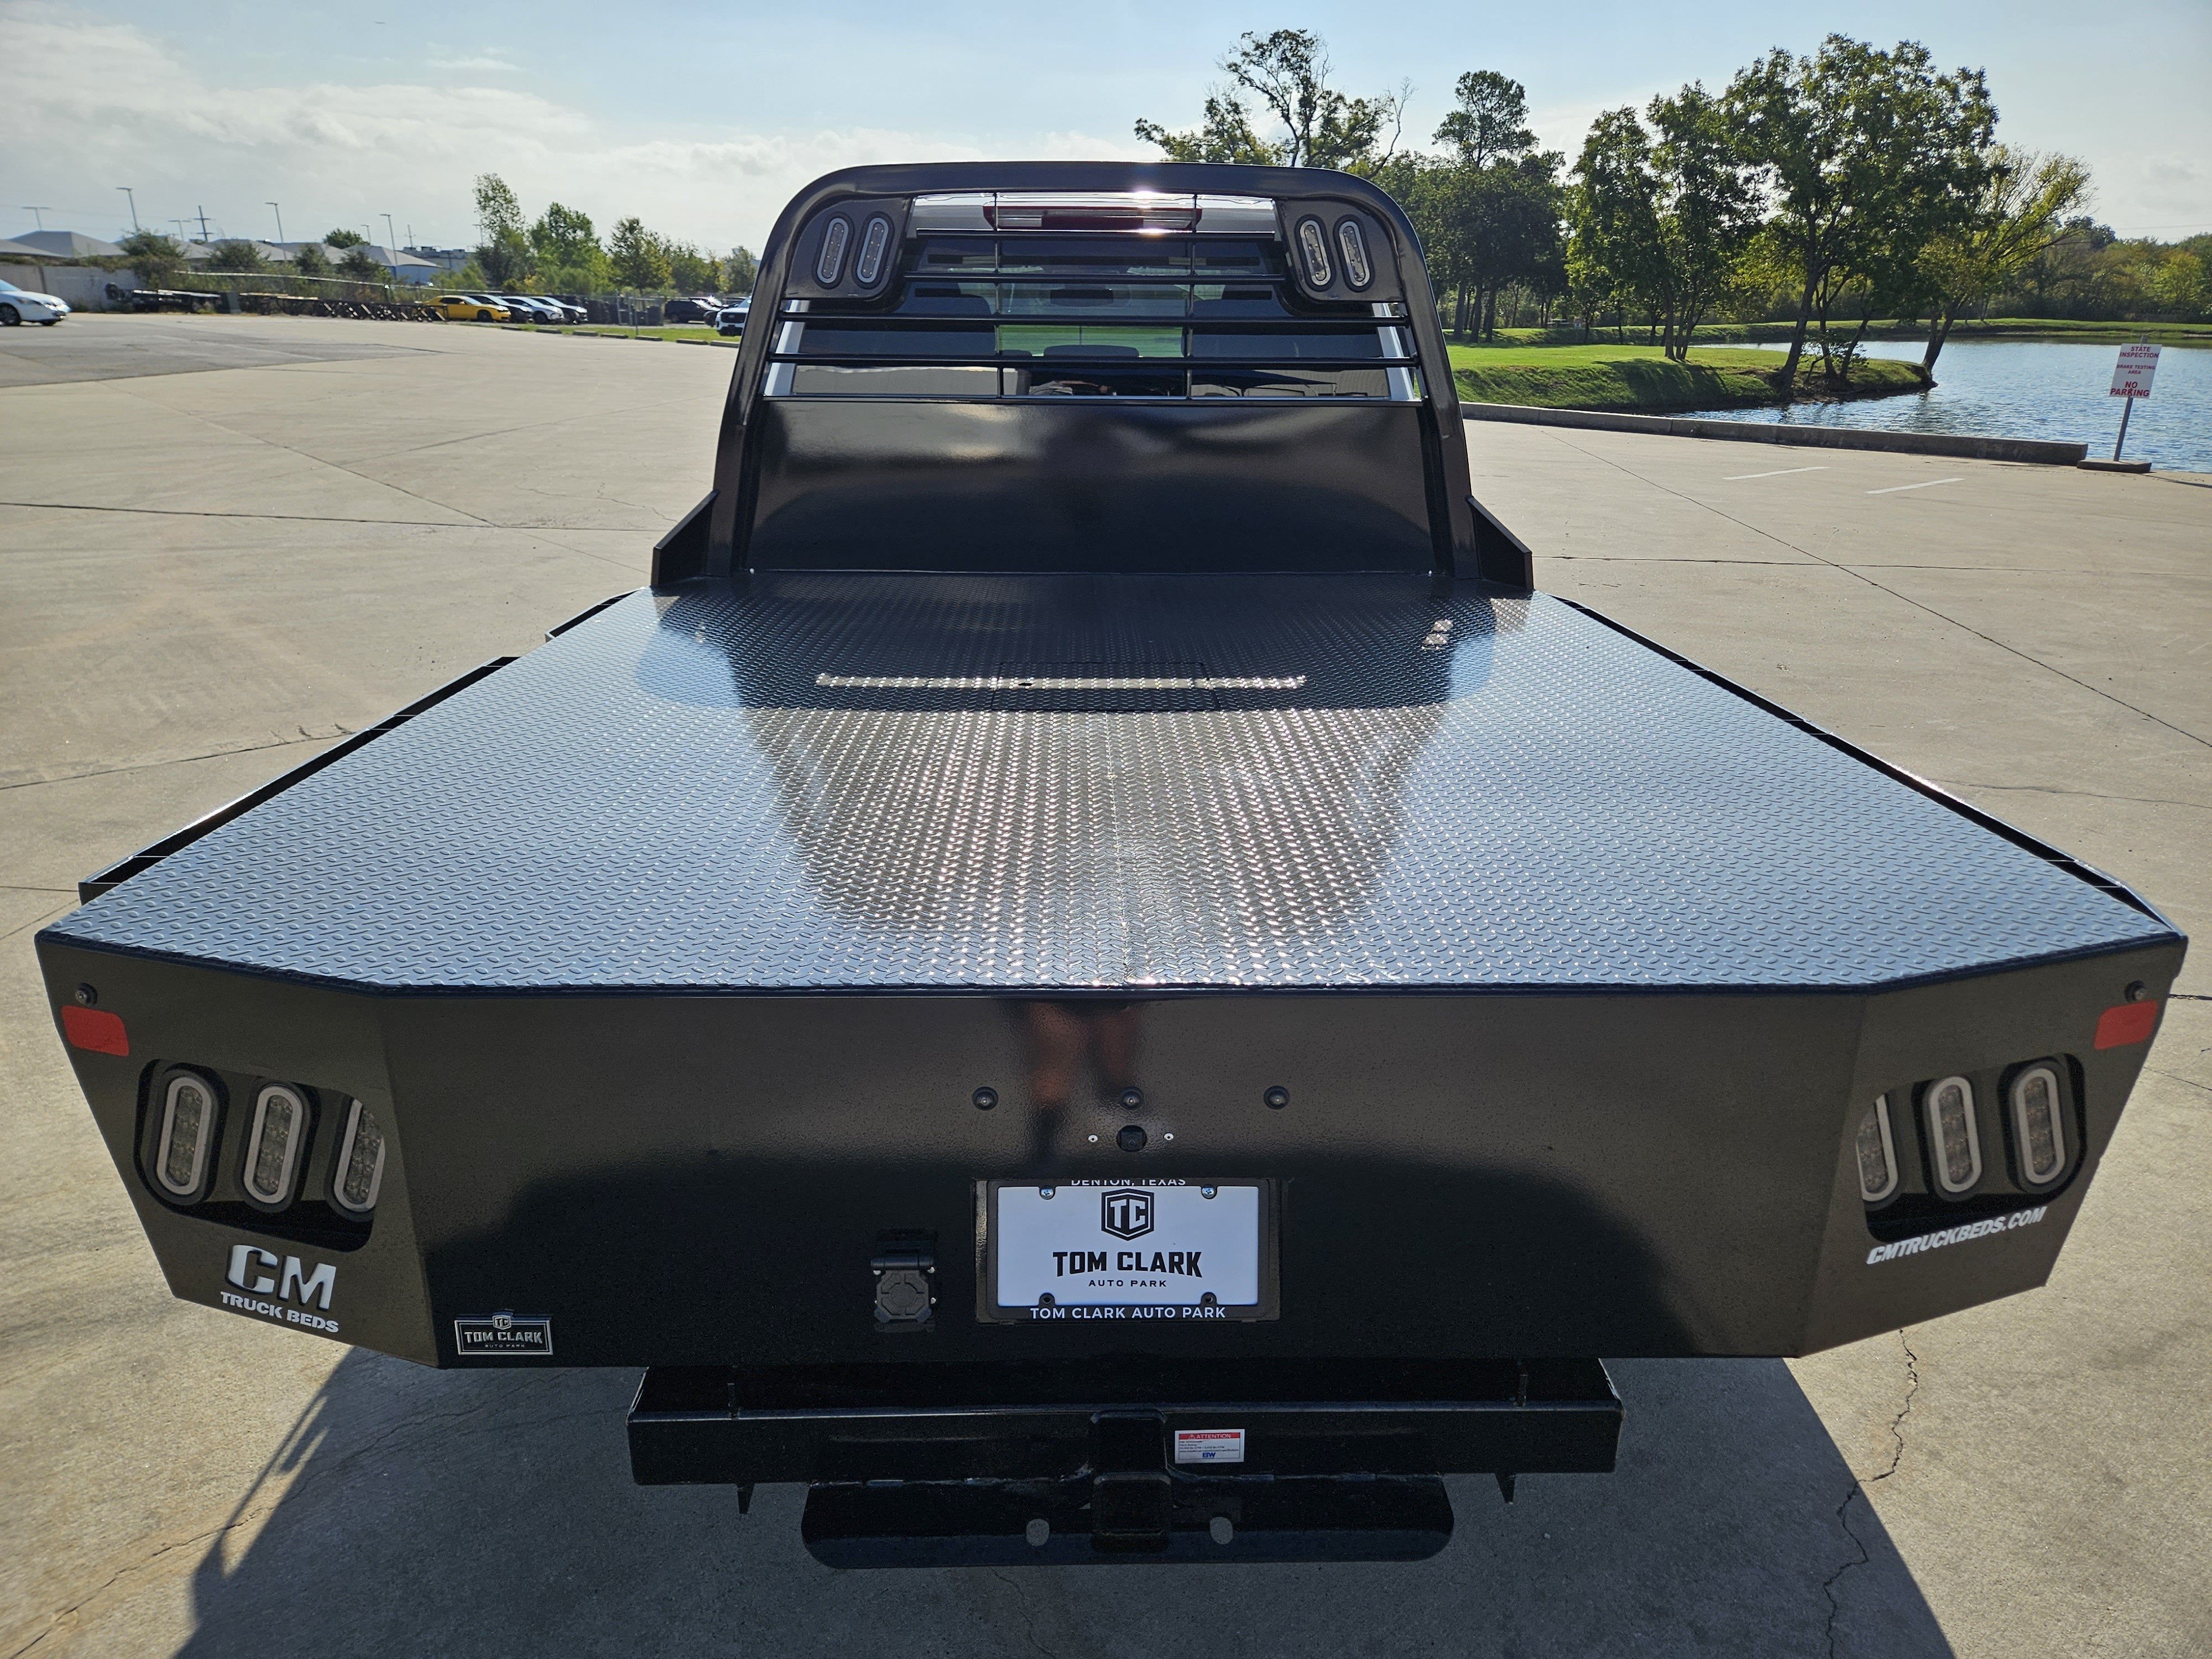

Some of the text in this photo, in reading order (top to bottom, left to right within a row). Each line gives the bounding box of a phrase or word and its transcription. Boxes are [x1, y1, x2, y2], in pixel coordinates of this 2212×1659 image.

[2110, 388, 2150, 397] PARKING
[1109, 1198, 1146, 1230] TC
[1866, 1206, 2047, 1265] CMTRUCKBEDS.COM
[226, 1245, 337, 1311] CM
[1052, 1251, 1203, 1278] TOM CLARK
[221, 1291, 339, 1333] TRUCK BEDS
[1030, 1307, 1226, 1319] TOM CLARK AUTO PARK
[465, 1332, 543, 1344] TOM CLARK
